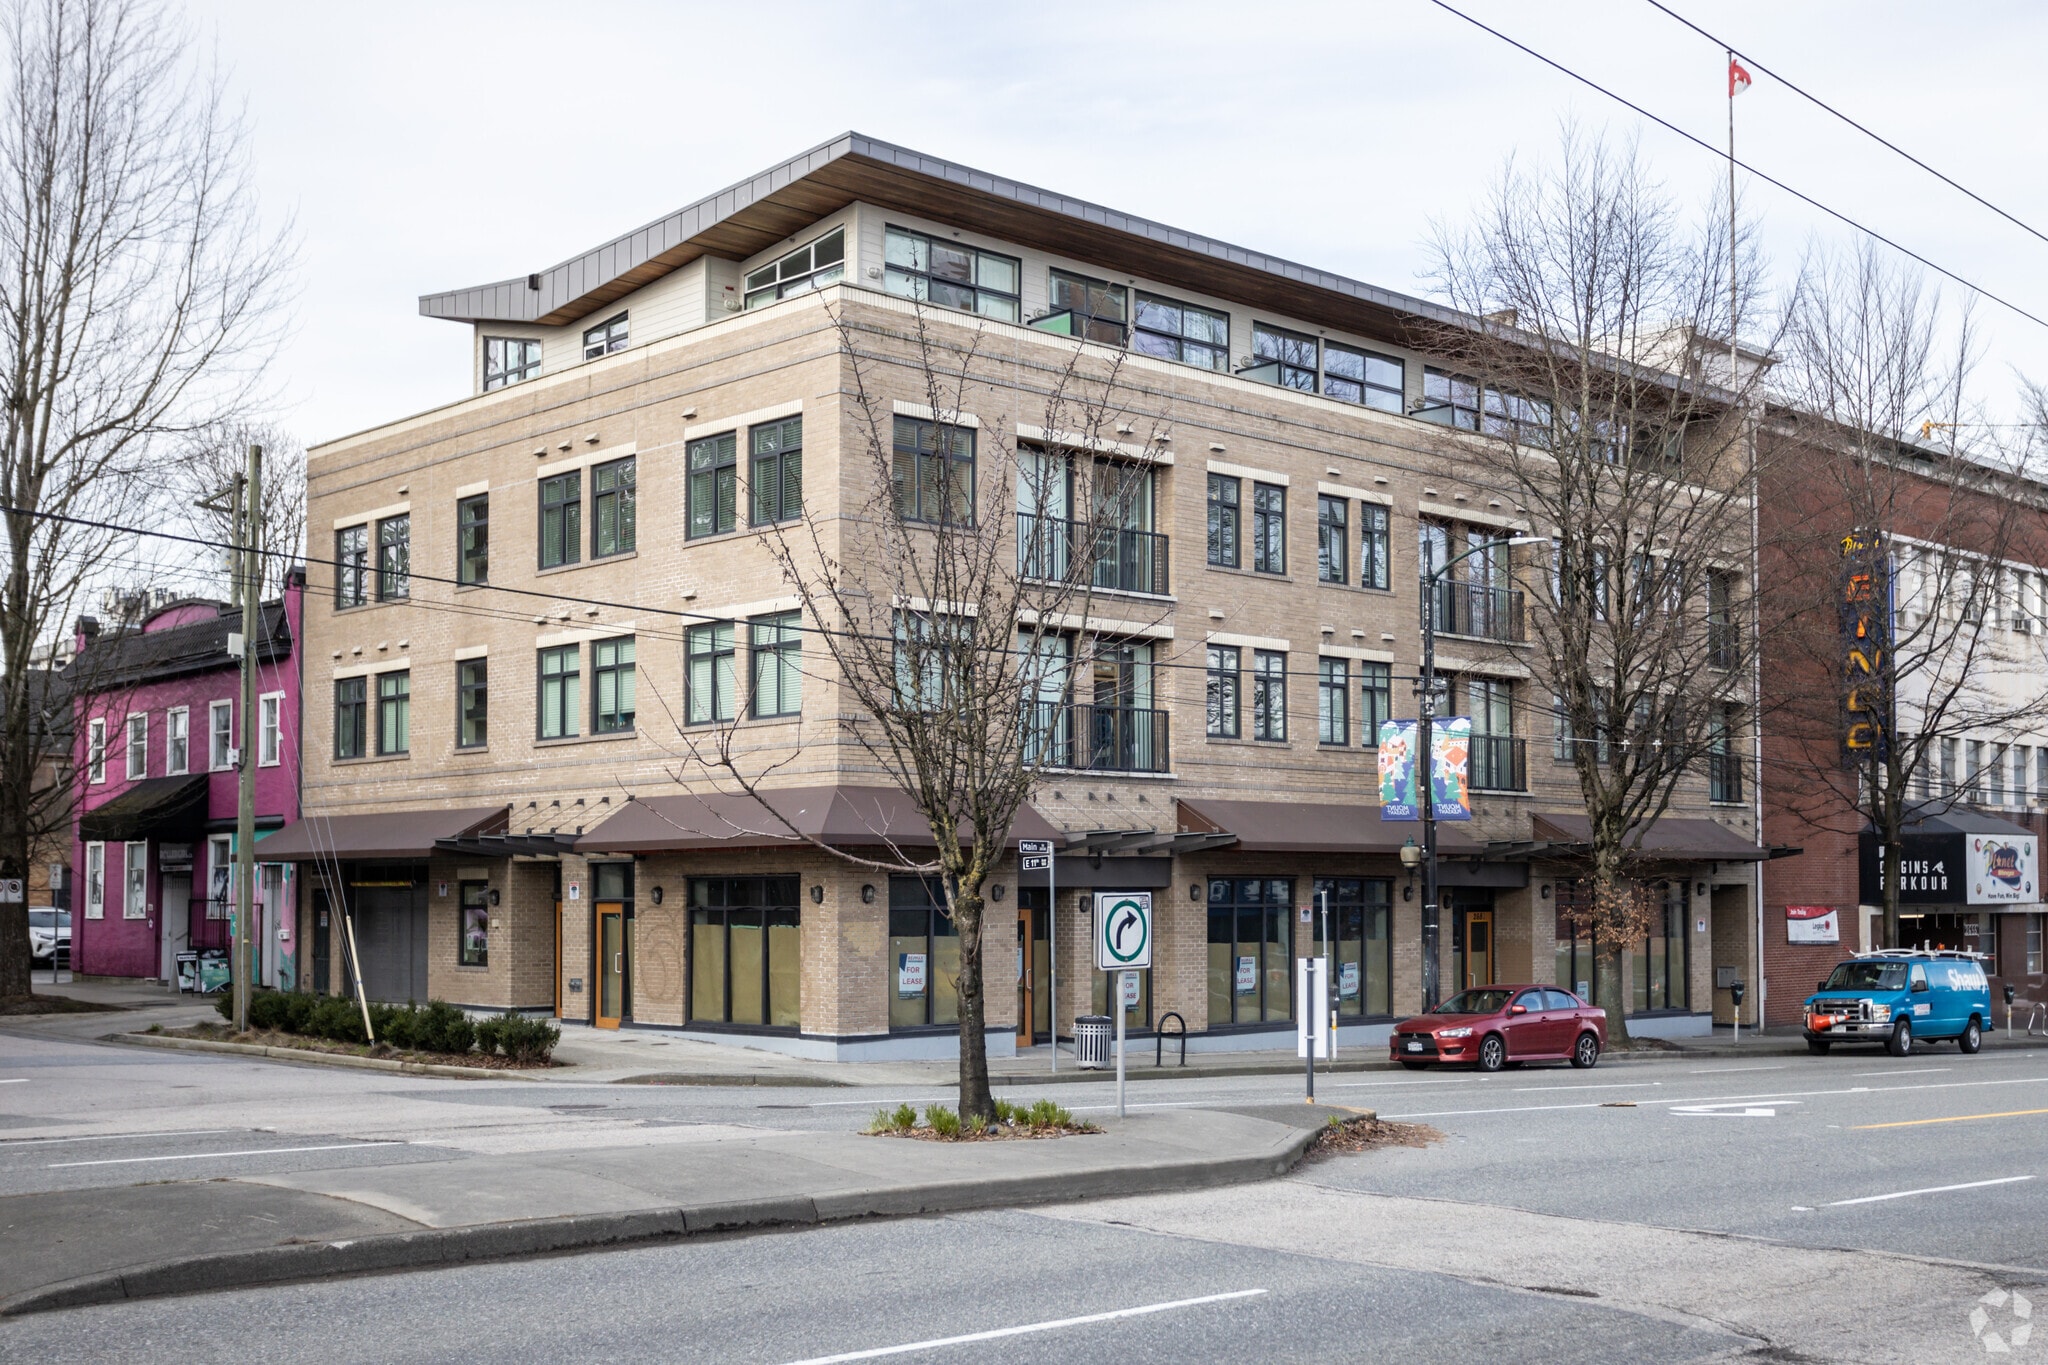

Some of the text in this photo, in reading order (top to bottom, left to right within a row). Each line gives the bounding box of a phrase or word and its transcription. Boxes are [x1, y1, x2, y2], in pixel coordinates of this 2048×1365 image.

[1022, 843, 1038, 851] Main
[1025, 860, 1030, 868] E
[1879, 860, 1929, 874] OGINS
[1879, 876, 1948, 891] PRKOUR
[1947, 968, 1984, 991] Shaw
[1125, 992, 1137, 1000] ASE
